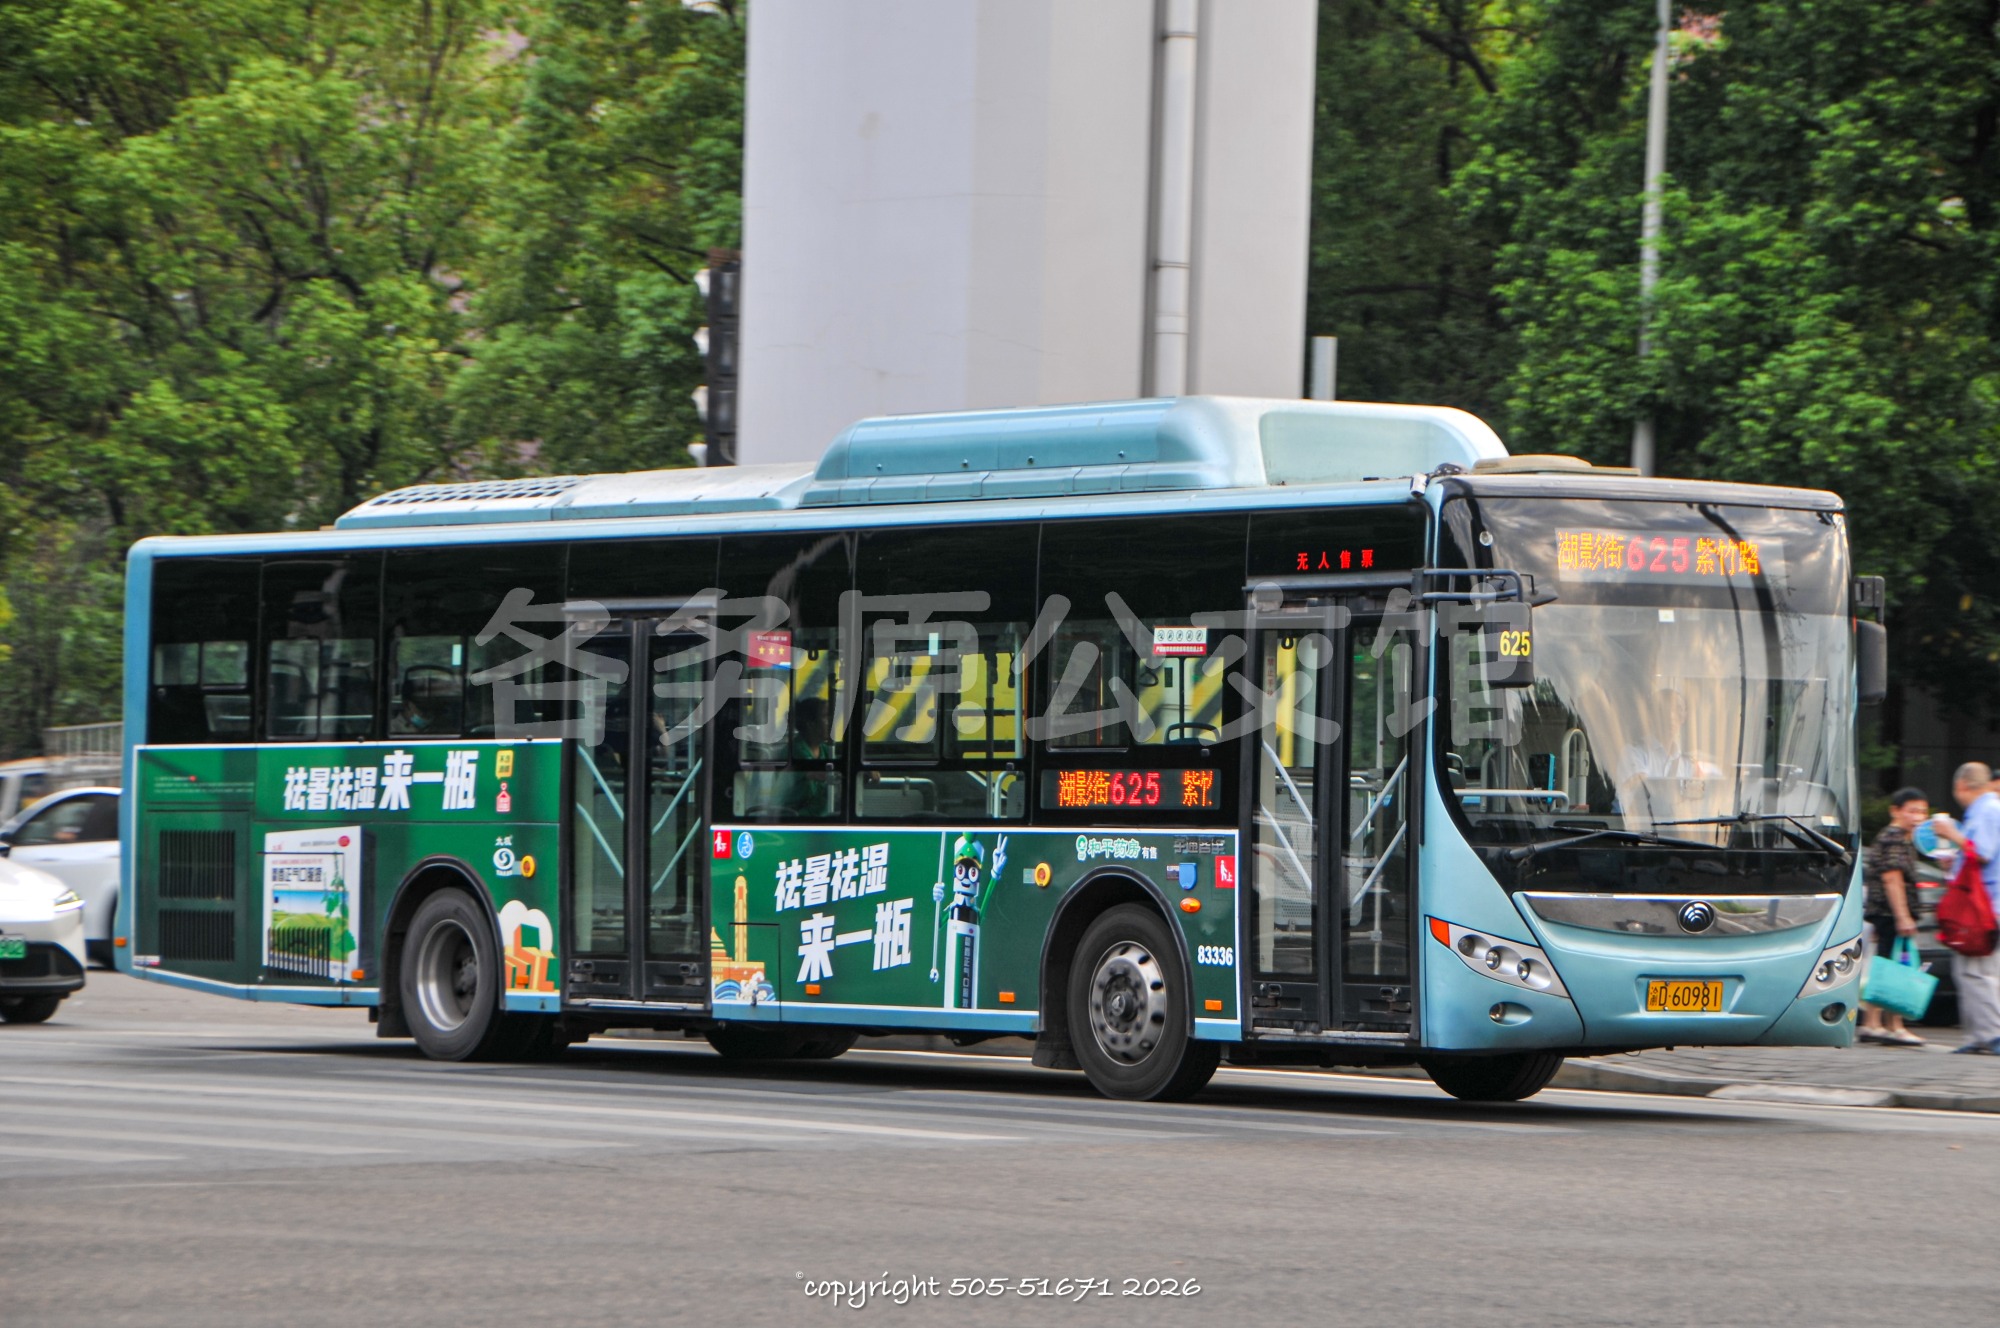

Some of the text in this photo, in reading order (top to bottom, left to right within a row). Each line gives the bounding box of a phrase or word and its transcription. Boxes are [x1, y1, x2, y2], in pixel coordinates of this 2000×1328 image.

[1297, 549, 1373, 570] 无人售票
[1627, 536, 1690, 573] 625
[1696, 537, 1761, 576] 紫竹路
[1500, 630, 1530, 656] 625
[284, 750, 479, 811] 祛暑祛湿 来一瓶
[1111, 772, 1160, 805] 625
[1087, 838, 1157, 859] 和平药房 有售
[774, 842, 889, 912] 祛暑祛湿
[1226, 870, 1233, 881] 上
[796, 898, 914, 982] 来一瓶
[1198, 945, 1234, 966] 83336
